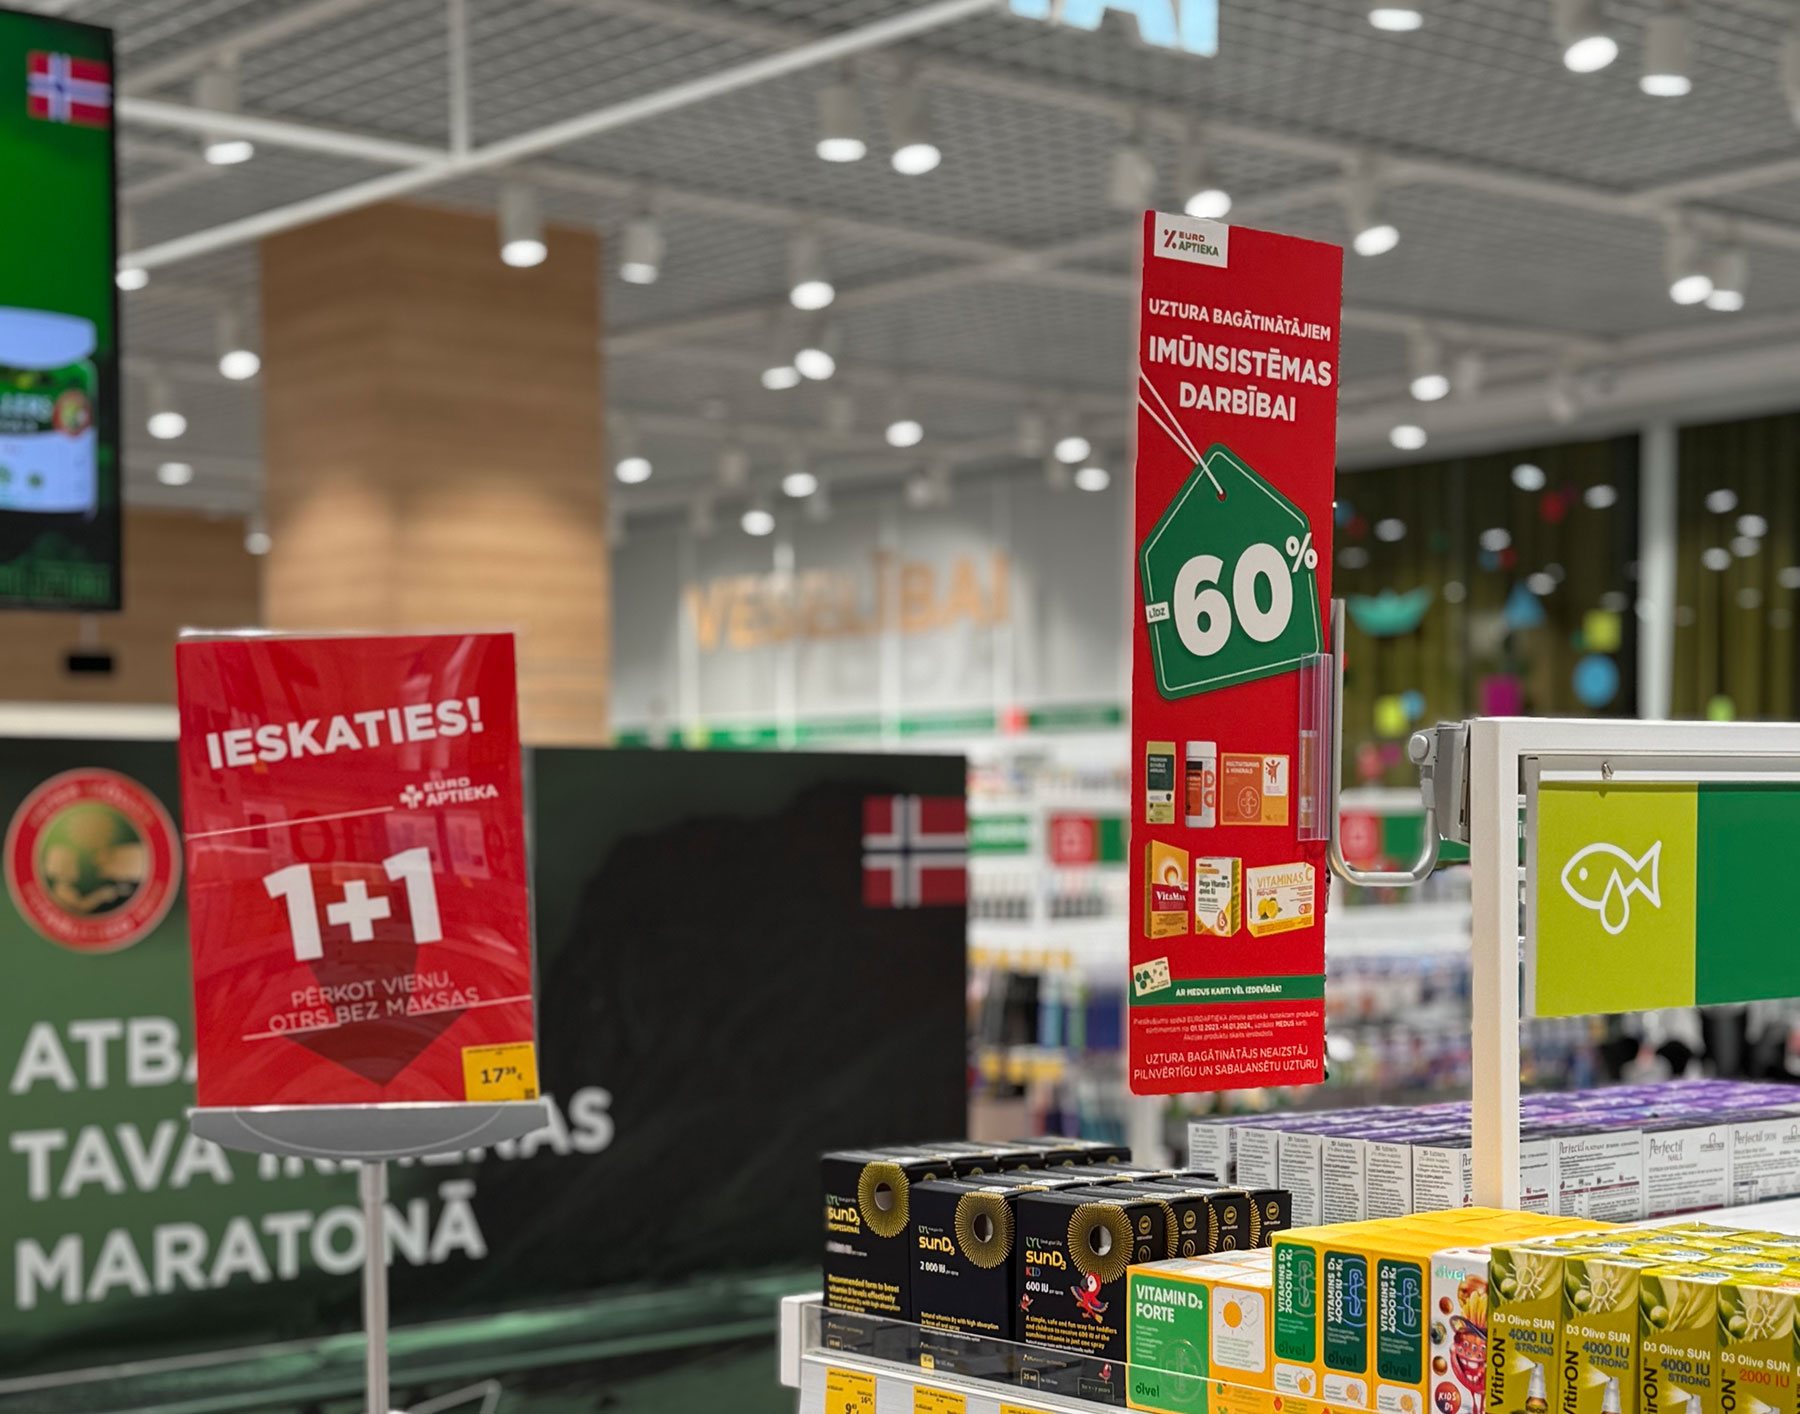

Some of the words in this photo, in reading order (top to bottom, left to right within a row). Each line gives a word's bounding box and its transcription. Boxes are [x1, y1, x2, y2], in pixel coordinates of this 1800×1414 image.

[1178, 231, 1205, 242] EURO
[1178, 241, 1219, 257] APTIEKA
[1149, 297, 1209, 322] UZTURA
[1213, 308, 1331, 341] BAGĀTINĀTĀJIEM
[1149, 334, 1332, 387] IMŪNSISTĒMAS
[1179, 380, 1296, 422] DARBĪBAI
[206, 696, 484, 770] IESKATIES!
[423, 776, 471, 793] EURO
[425, 784, 499, 807] APTIEKA
[1257, 872, 1303, 888] VITAMINAS
[1304, 867, 1313, 881] C
[262, 847, 442, 961] 1+1
[291, 984, 376, 1009] PĒRKOT
[1176, 988, 1185, 997] AR
[1232, 985, 1245, 995] VĒL
[268, 1010, 330, 1033] OTRS
[335, 1001, 380, 1025] BEZ
[386, 987, 481, 1016] MAKSAS
[10, 1016, 197, 1095] ATB
[1146, 1051, 1185, 1065] UZTURA
[1187, 1047, 1258, 1063] BAGĀTINĀTĀJS
[1260, 1043, 1309, 1058] NEAIZSTĀJ
[1134, 1065, 1197, 1080] PILNVĒRTĪGU
[1200, 1065, 1213, 1076] UN
[1215, 1060, 1280, 1075] SABALANSĒTU
[1283, 1059, 1319, 1071] UZTURU
[1560, 1140, 1585, 1155] Perfectil
[1649, 1138, 1684, 1159] Perfectil
[1734, 1130, 1763, 1146] Perfectil
[13, 1180, 487, 1311] MARATONĀ
[1025, 1266, 1041, 1277] KID
[1285, 1270, 1293, 1280] IU
[1026, 1280, 1040, 1292] 600
[1041, 1282, 1049, 1293] IU
[1278, 1264, 1286, 1313] VITAMINS
[1335, 1280, 1343, 1290] IU
[1388, 1289, 1397, 1299] IU
[1136, 1284, 1186, 1307] VITAMIN
[1188, 1293, 1203, 1310] D3
[1285, 1281, 1293, 1314] 2000
[1327, 1273, 1335, 1323] VITAMINS
[1335, 1291, 1343, 1324] 4000
[1380, 1281, 1389, 1332] VITAMINS
[1136, 1302, 1175, 1323] FORTE
[1388, 1300, 1397, 1334] 4000
[1493, 1312, 1506, 1323] D3
[1507, 1314, 1531, 1327] Olive
[1533, 1317, 1555, 1330] SUN
[1508, 1328, 1537, 1343] 4000
[1540, 1332, 1554, 1345] IU
[1566, 1324, 1579, 1336] D3
[1581, 1326, 1605, 1340] Olive
[1608, 1331, 1630, 1344] SUN
[1515, 1342, 1554, 1356] STRONG
[1582, 1341, 1612, 1356] 4000
[1615, 1345, 1630, 1359] IU
[1643, 1341, 1657, 1352] D3
[1659, 1343, 1684, 1357] Olive
[1686, 1347, 1711, 1361] SUN
[1589, 1355, 1629, 1370] STRONG
[1661, 1358, 1692, 1374] 4000
[1695, 1362, 1710, 1377] IU
[1721, 1351, 1735, 1363] D3
[1737, 1354, 1764, 1368] Olive
[1766, 1359, 1791, 1373] SUN
[1668, 1373, 1711, 1388] STRONG
[1739, 1369, 1771, 1385] 2000
[1776, 1375, 1790, 1389] IU
[1438, 1391, 1456, 1402] KIDS
